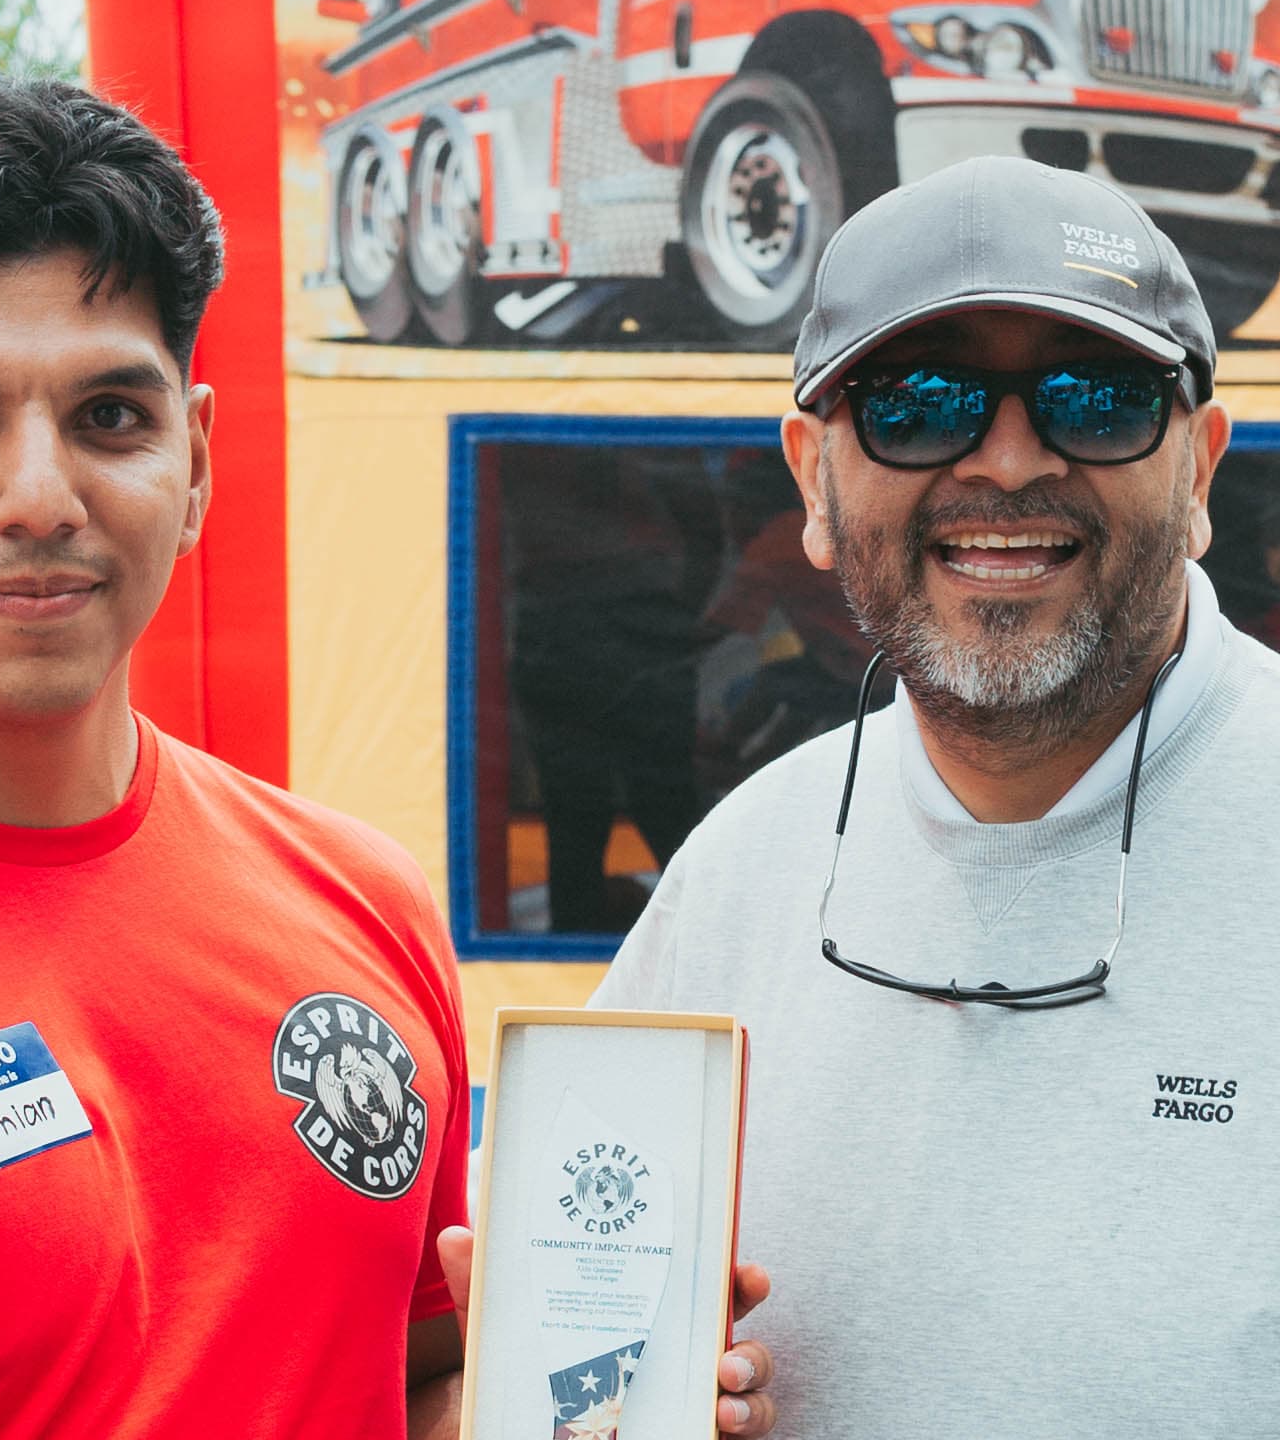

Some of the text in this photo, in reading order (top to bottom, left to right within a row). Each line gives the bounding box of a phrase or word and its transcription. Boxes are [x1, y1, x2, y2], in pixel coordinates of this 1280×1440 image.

[1059, 222, 1136, 252] WELLS
[1064, 240, 1140, 269] FARGO
[282, 1004, 406, 1082] ESPRIT
[6, 1070, 18, 1082] is
[1156, 1074, 1237, 1098] WELLS
[1152, 1099, 1233, 1123] FARGO
[306, 1102, 424, 1186] DE CORPS
[562, 1144, 650, 1178] ESPRIT
[560, 1194, 648, 1234] DE CORPS
[531, 1239, 592, 1250] COMMUNITY
[595, 1242, 632, 1253] IMPACT
